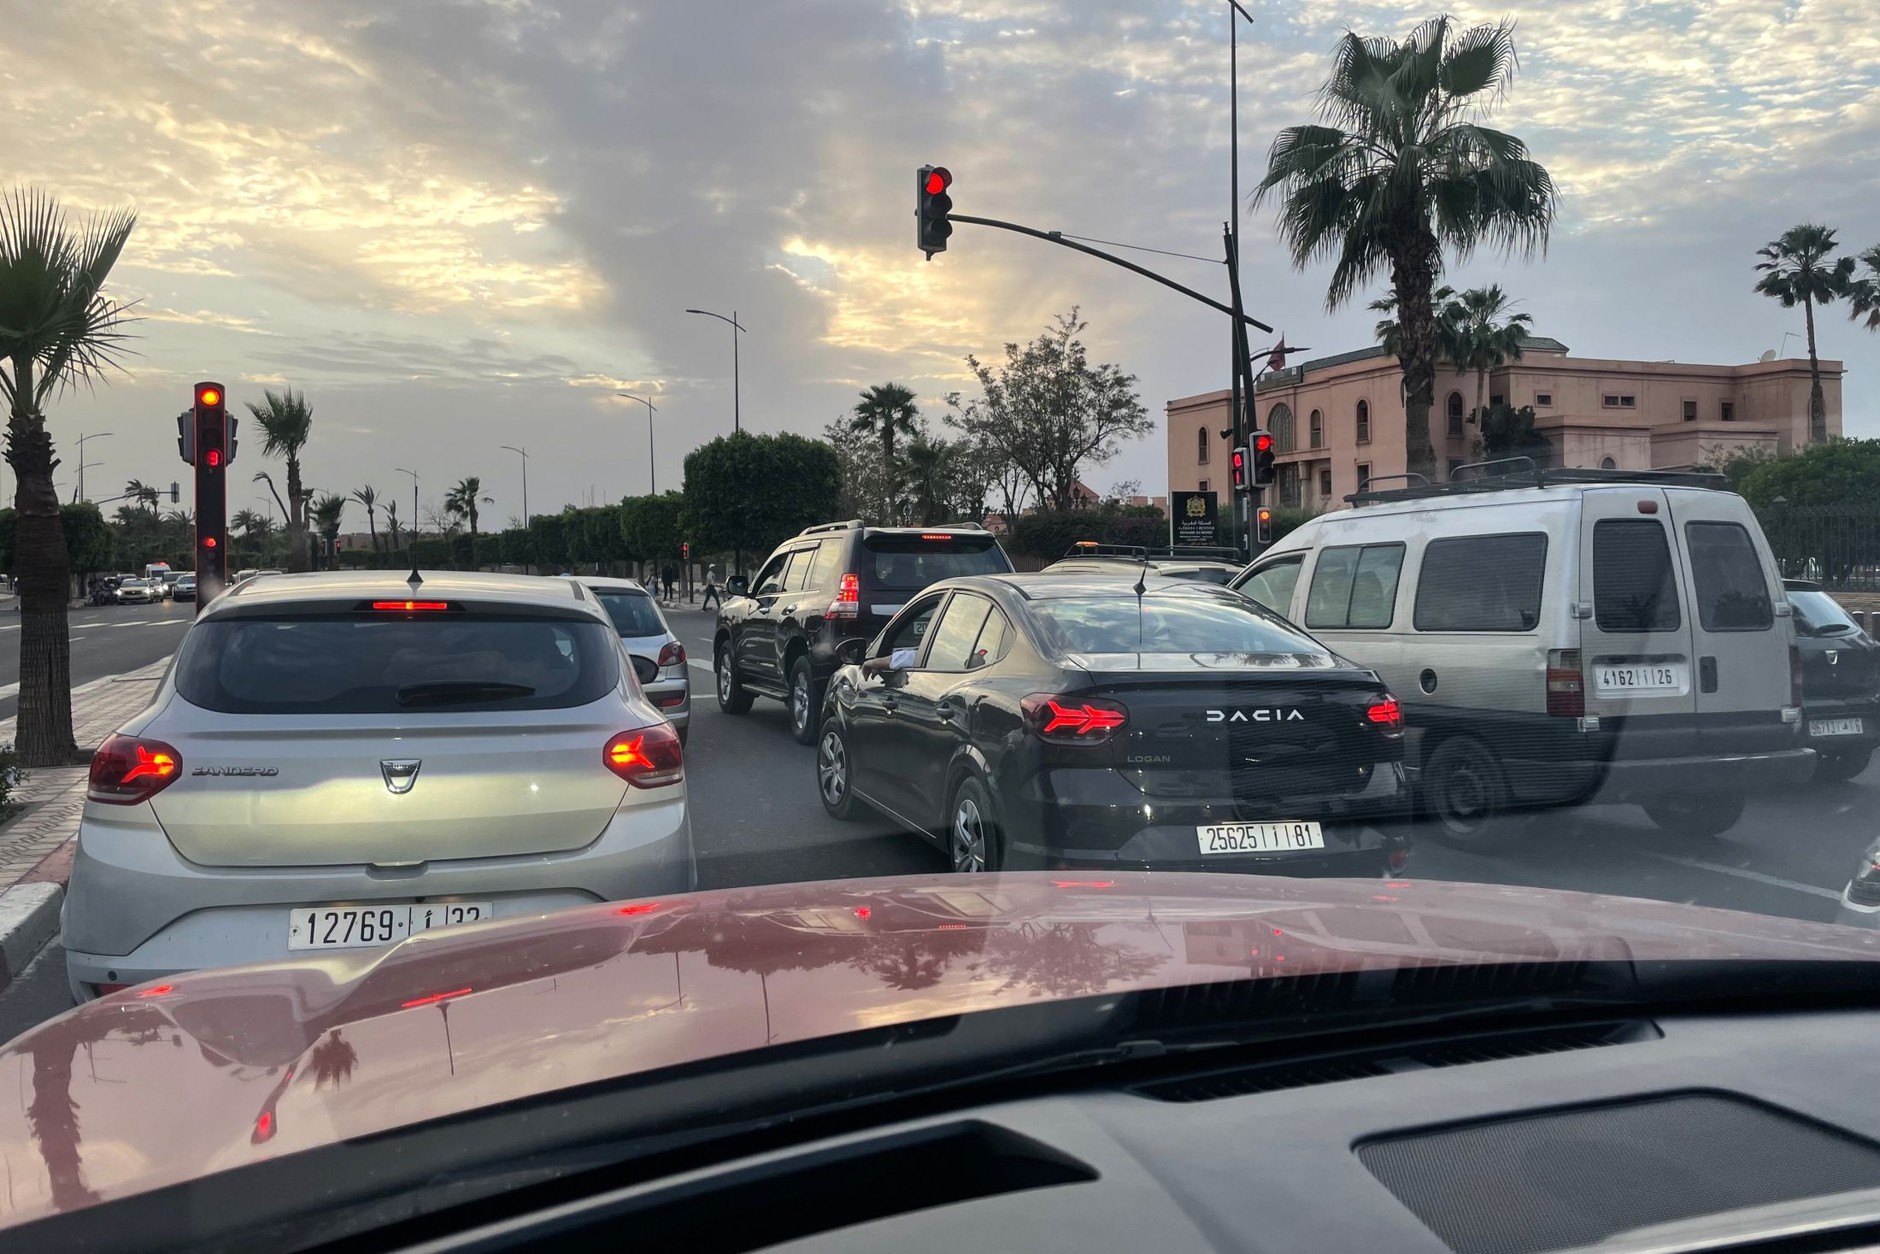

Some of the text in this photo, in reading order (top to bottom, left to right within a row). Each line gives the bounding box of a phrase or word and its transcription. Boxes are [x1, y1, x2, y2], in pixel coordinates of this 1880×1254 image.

[1603, 670, 1634, 686] 4162
[1657, 669, 1672, 685] 26
[1206, 709, 1305, 722] DACIA
[1127, 755, 1171, 763] LOGAN
[191, 766, 279, 776] SANDERO
[1206, 826, 1258, 851] 25625
[1293, 824, 1313, 847] 81
[308, 910, 394, 945] 12769
